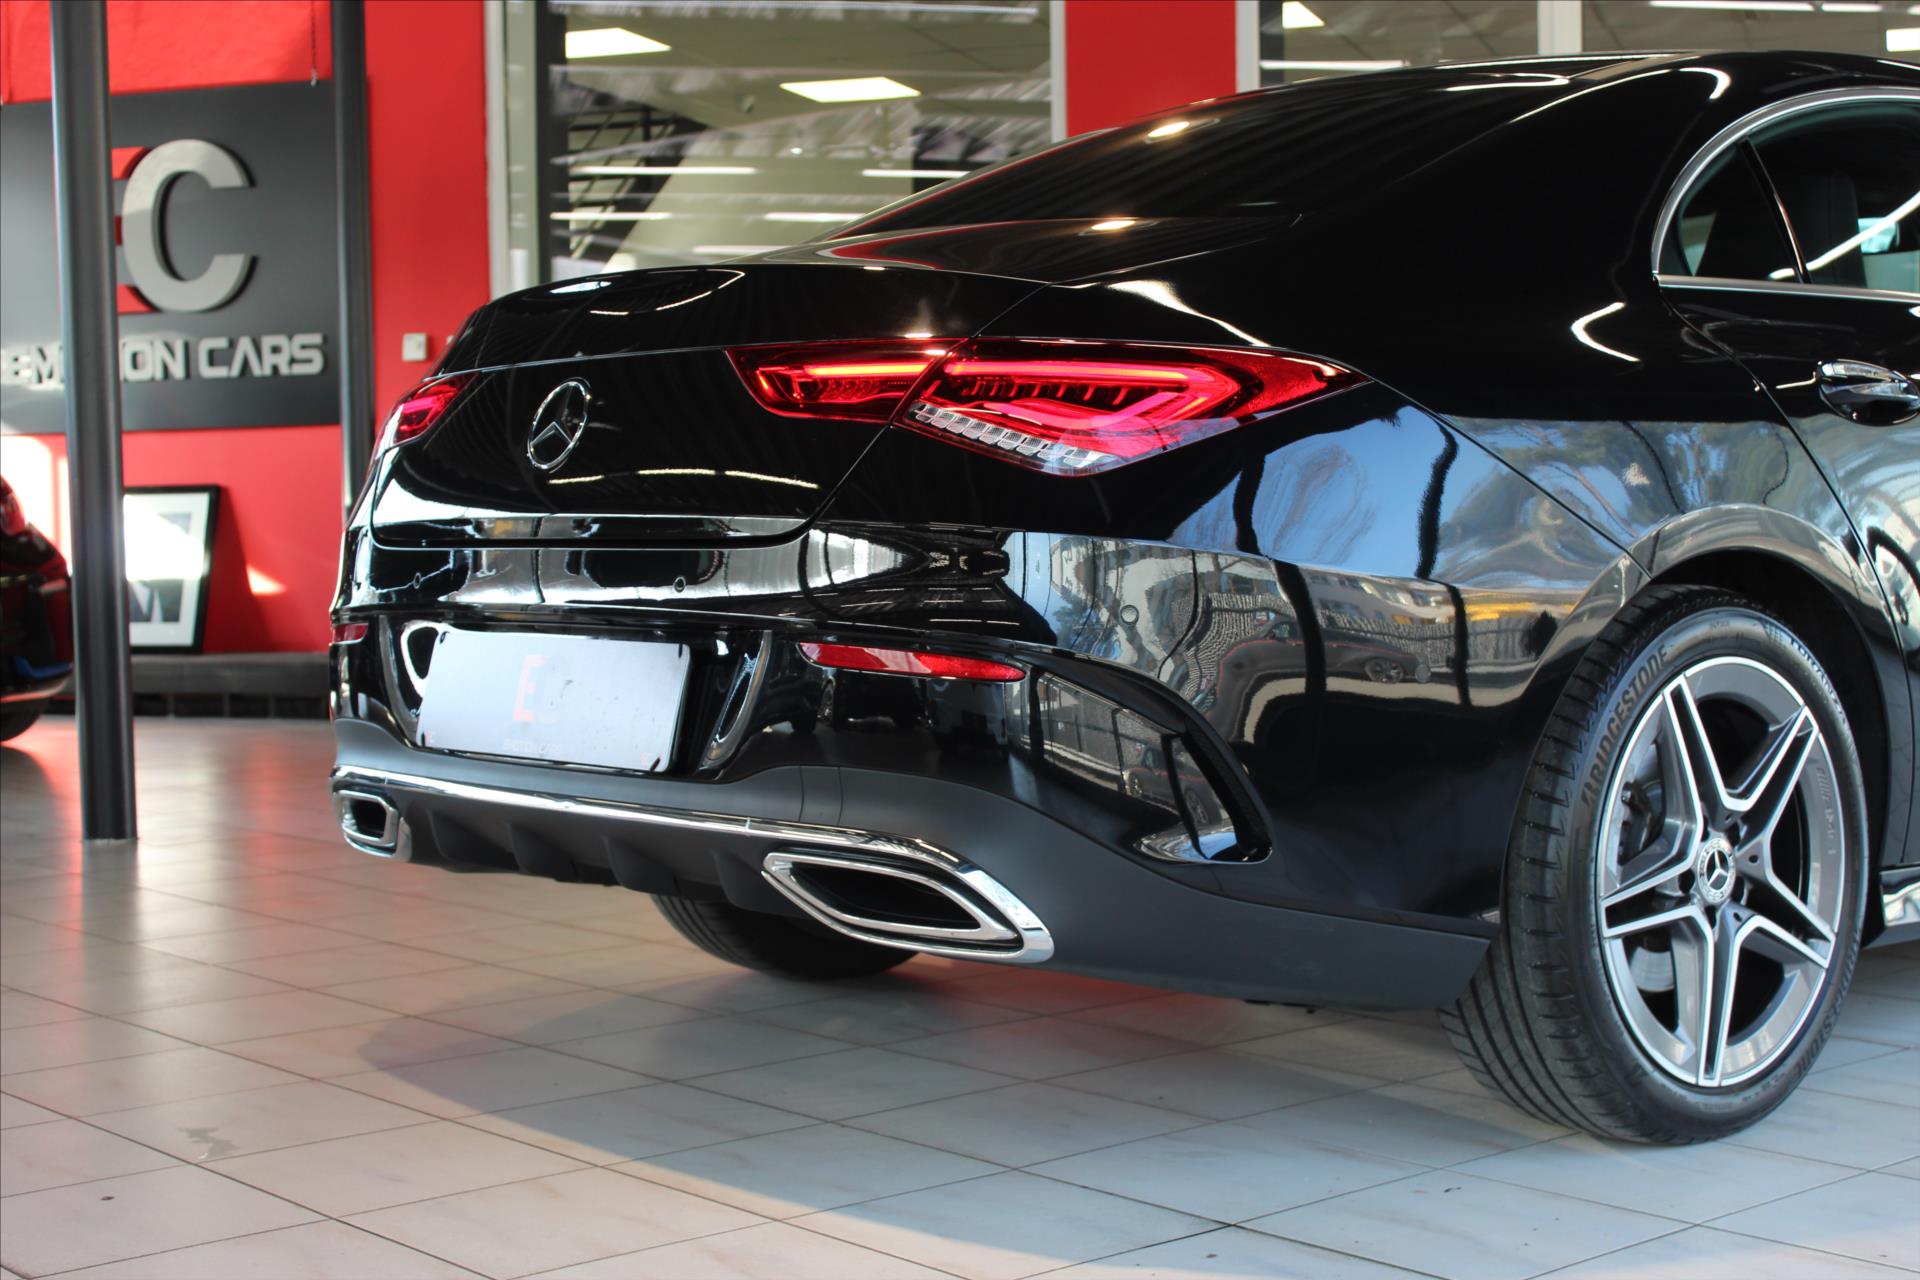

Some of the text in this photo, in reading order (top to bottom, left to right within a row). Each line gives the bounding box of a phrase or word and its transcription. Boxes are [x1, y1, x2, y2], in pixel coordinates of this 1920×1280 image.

[5, 333, 324, 384] EMON CARS
[1581, 644, 1668, 808] BRIDGESTONE
